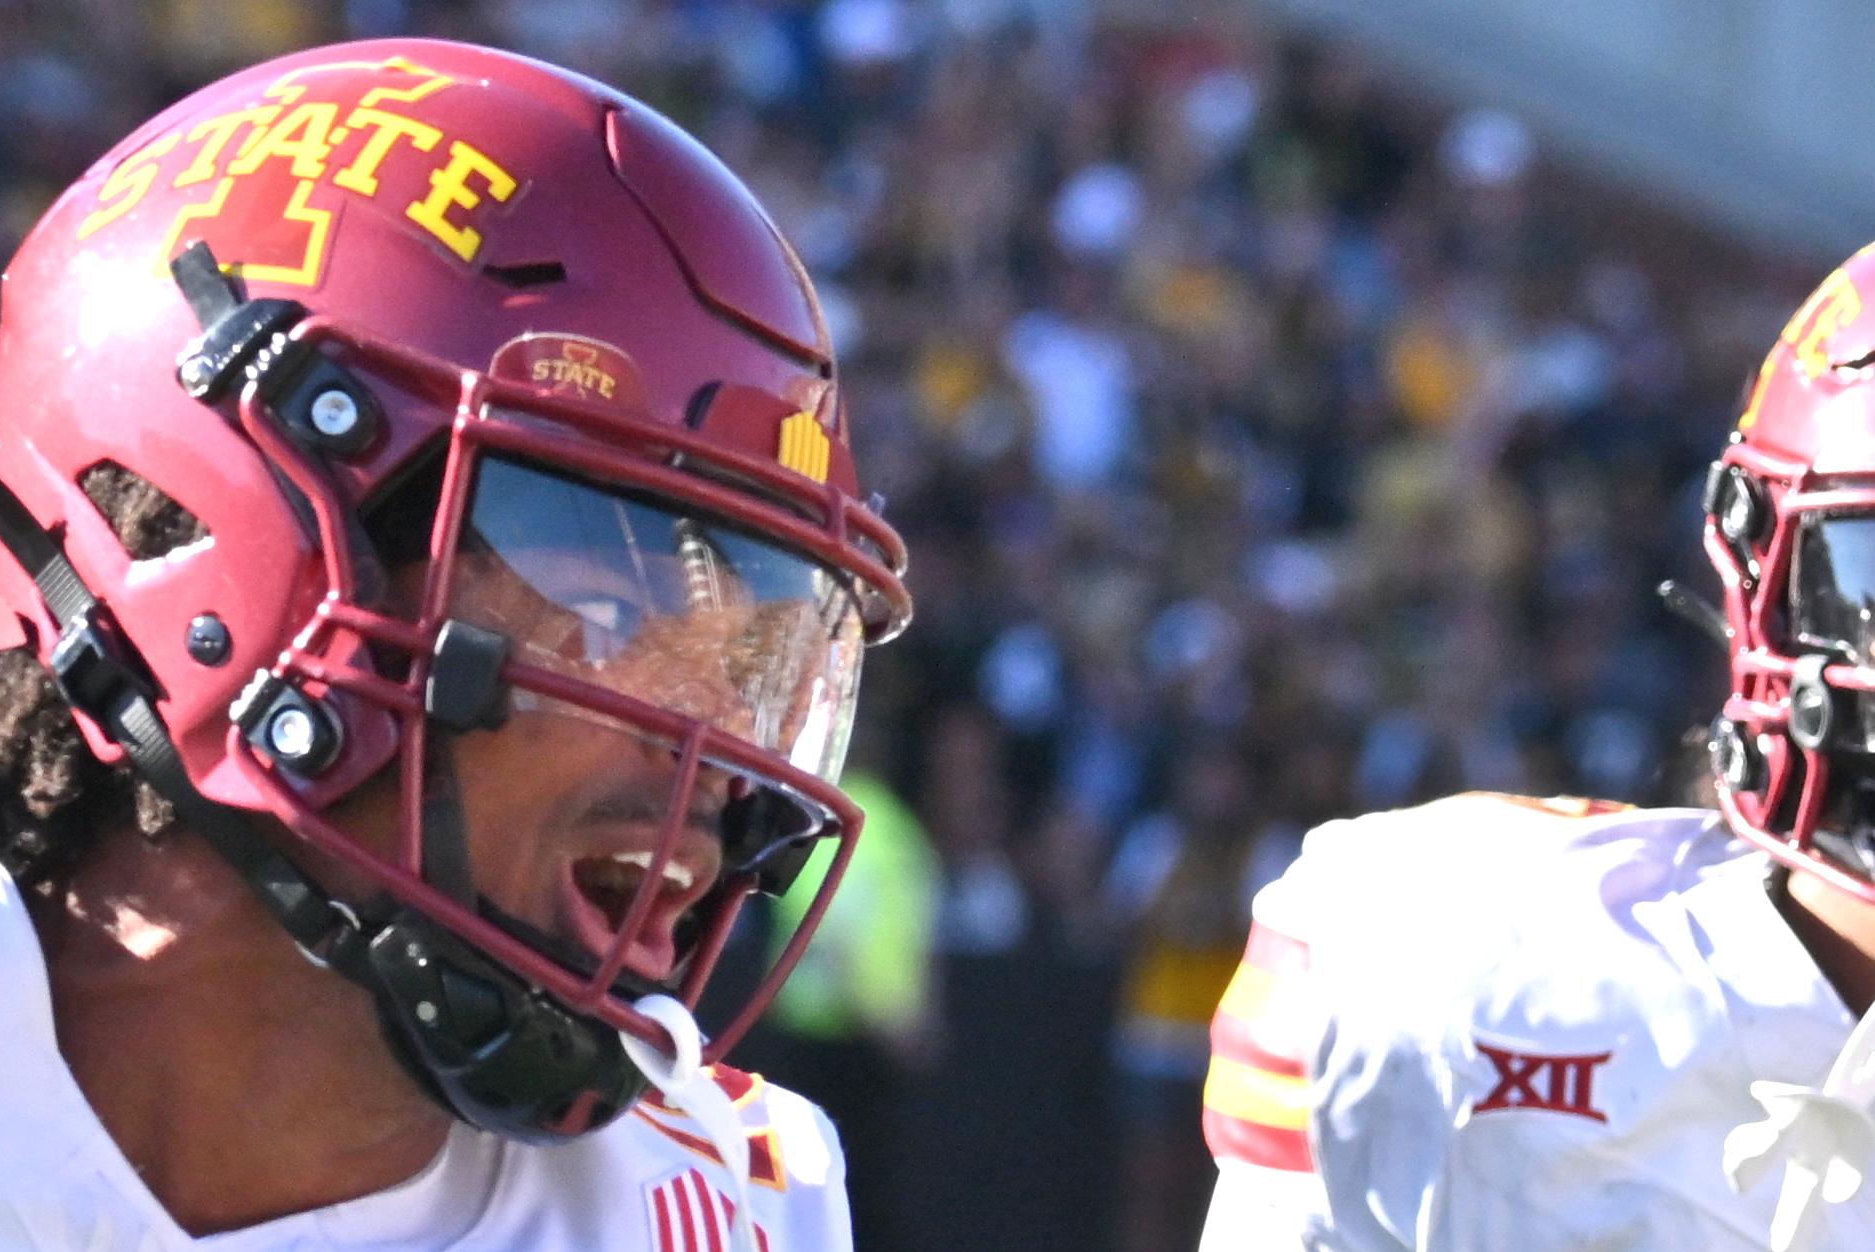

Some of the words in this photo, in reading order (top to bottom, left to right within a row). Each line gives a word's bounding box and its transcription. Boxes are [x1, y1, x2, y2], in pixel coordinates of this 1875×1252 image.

[76, 102, 518, 263] STATE
[532, 359, 616, 399] STATE
[1471, 1041, 1613, 1124] XII
